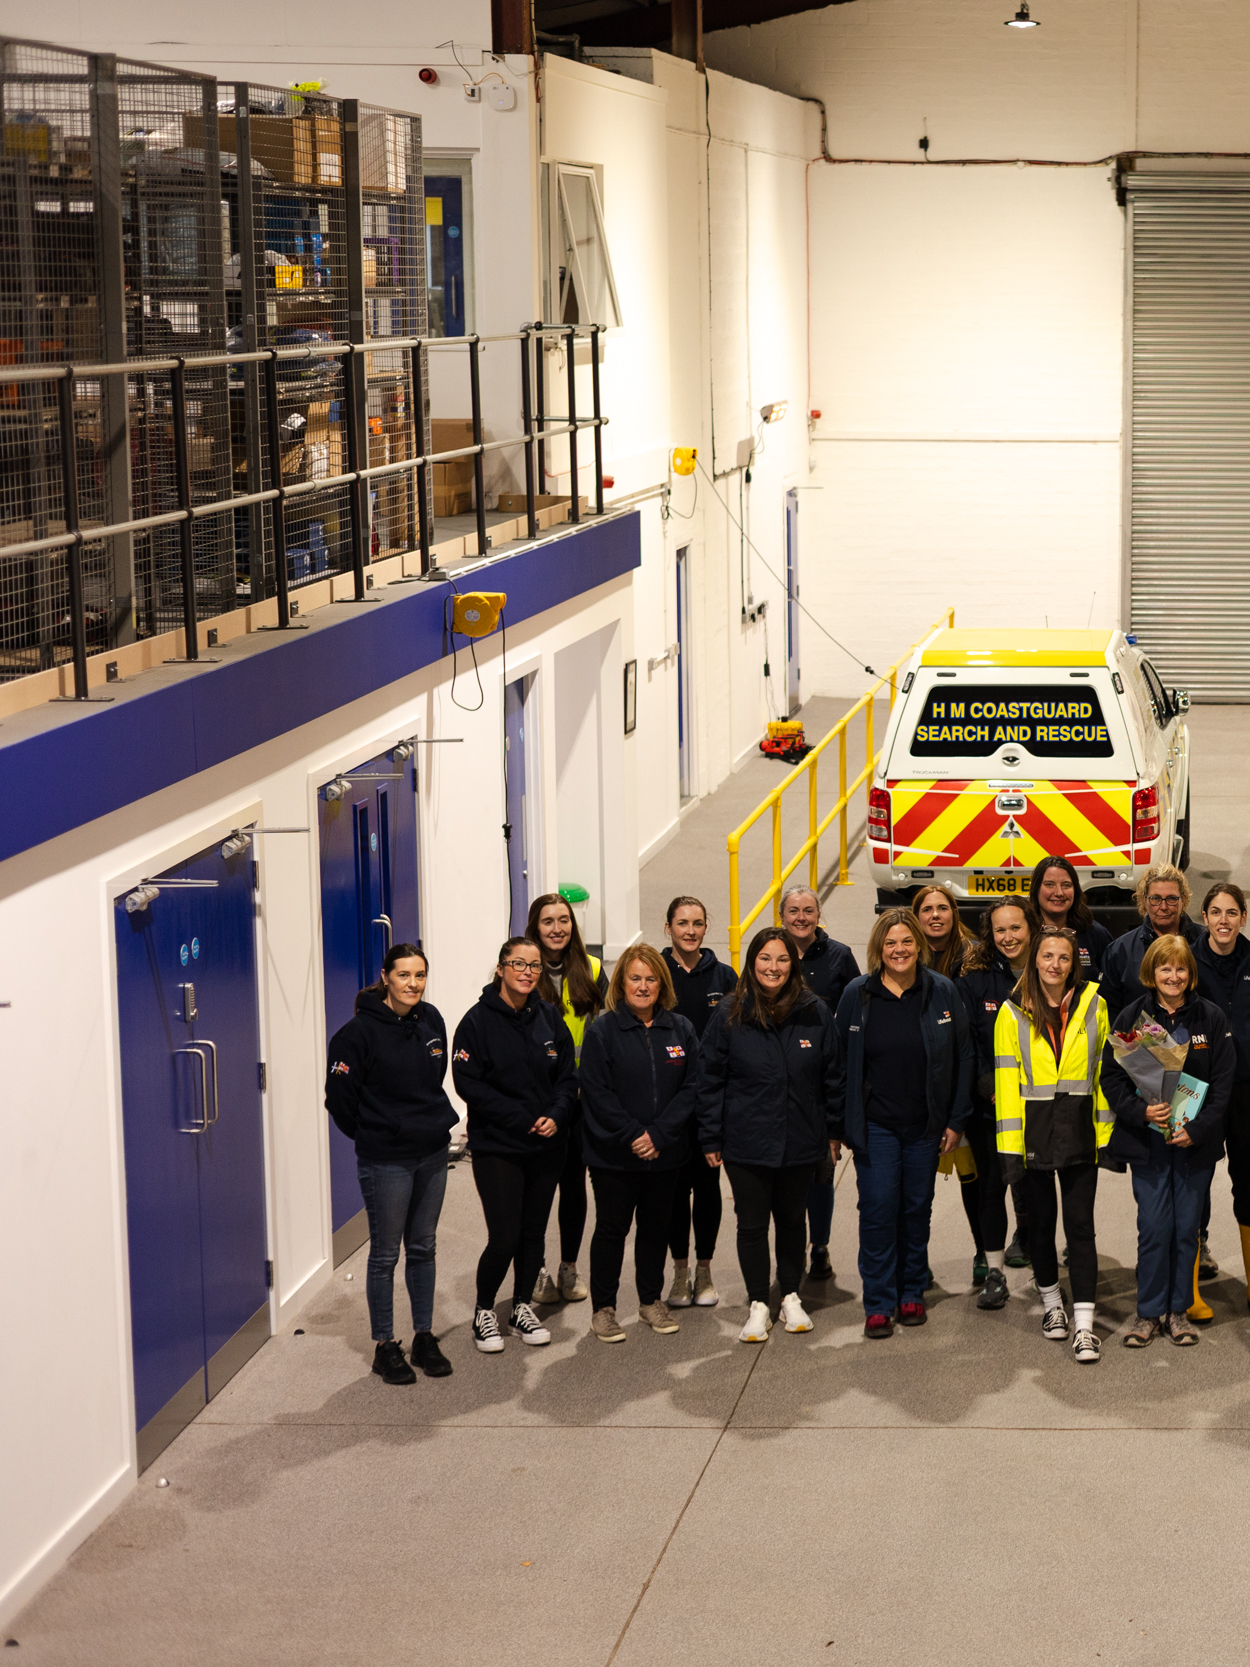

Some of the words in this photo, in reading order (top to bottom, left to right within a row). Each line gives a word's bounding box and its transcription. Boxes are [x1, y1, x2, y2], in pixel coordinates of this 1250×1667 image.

[932, 702, 945, 718] H
[950, 702, 965, 718] M
[969, 702, 1092, 718] COASTGUARD
[916, 725, 989, 741] SEARCH
[993, 725, 1031, 741] AND
[1035, 725, 1107, 741] RESCUE
[975, 878, 1017, 892] HX68
